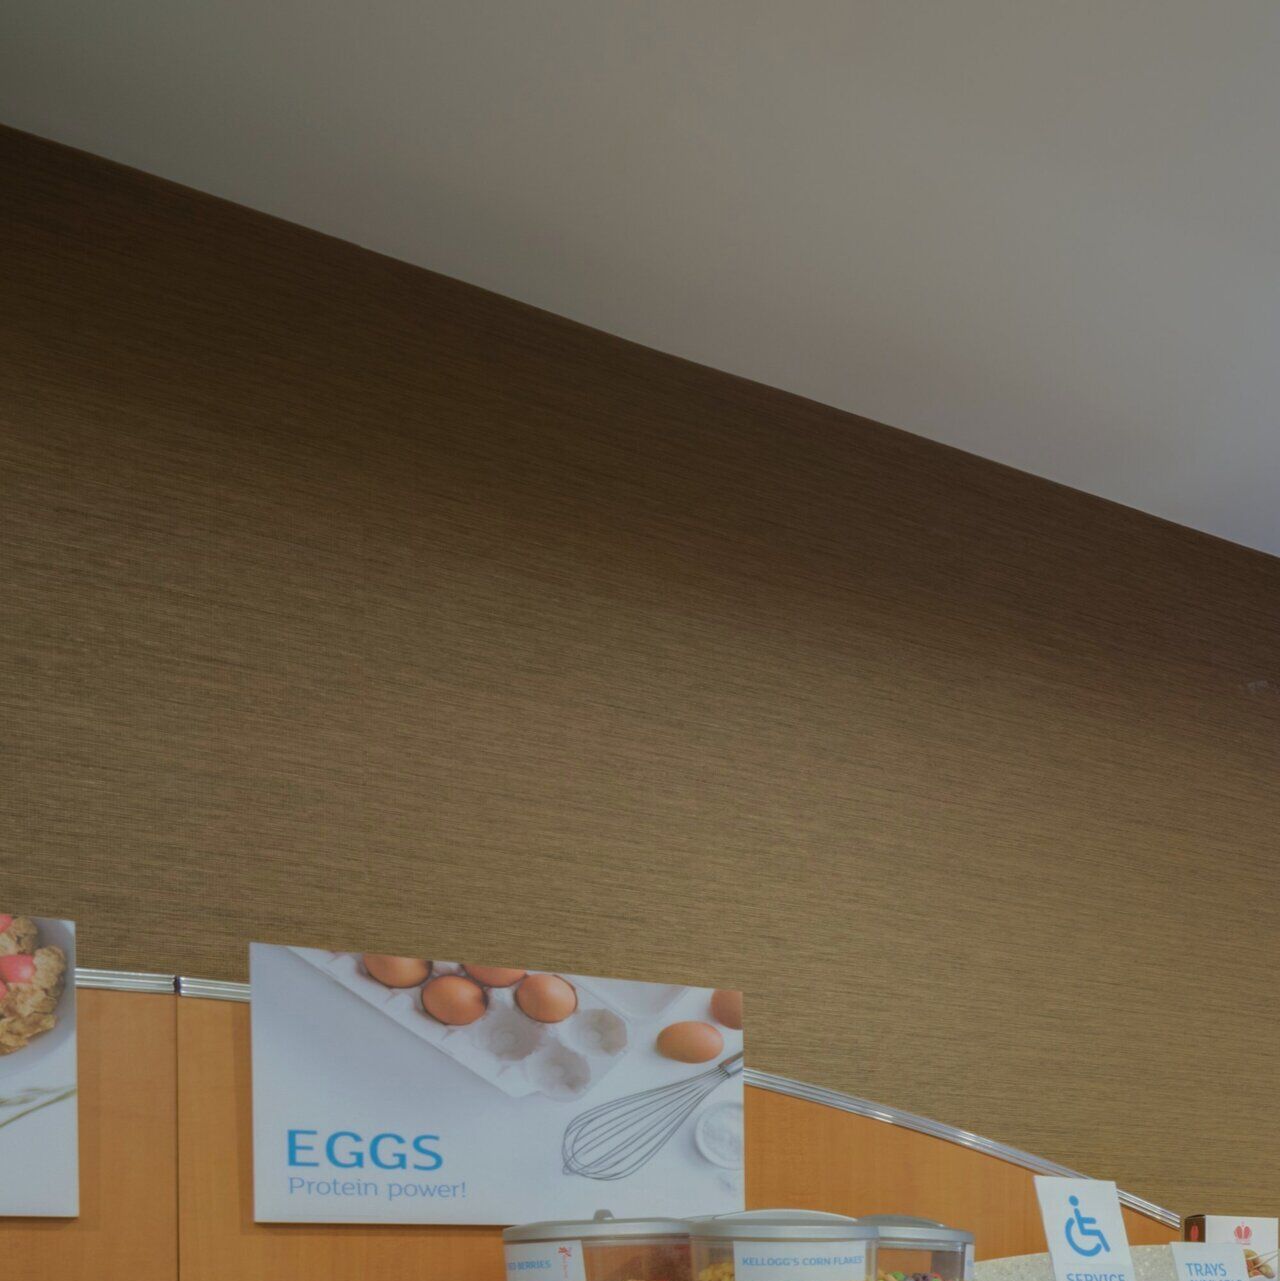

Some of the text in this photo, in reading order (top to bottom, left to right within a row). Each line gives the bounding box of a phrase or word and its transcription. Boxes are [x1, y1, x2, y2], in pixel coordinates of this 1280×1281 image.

[287, 1129, 443, 1171] EGGS
[289, 1176, 466, 1200] Protein power!
[742, 1256, 800, 1266] KELLOGG'S
[802, 1256, 830, 1266] CORN
[1185, 1262, 1227, 1277] TRAYS
